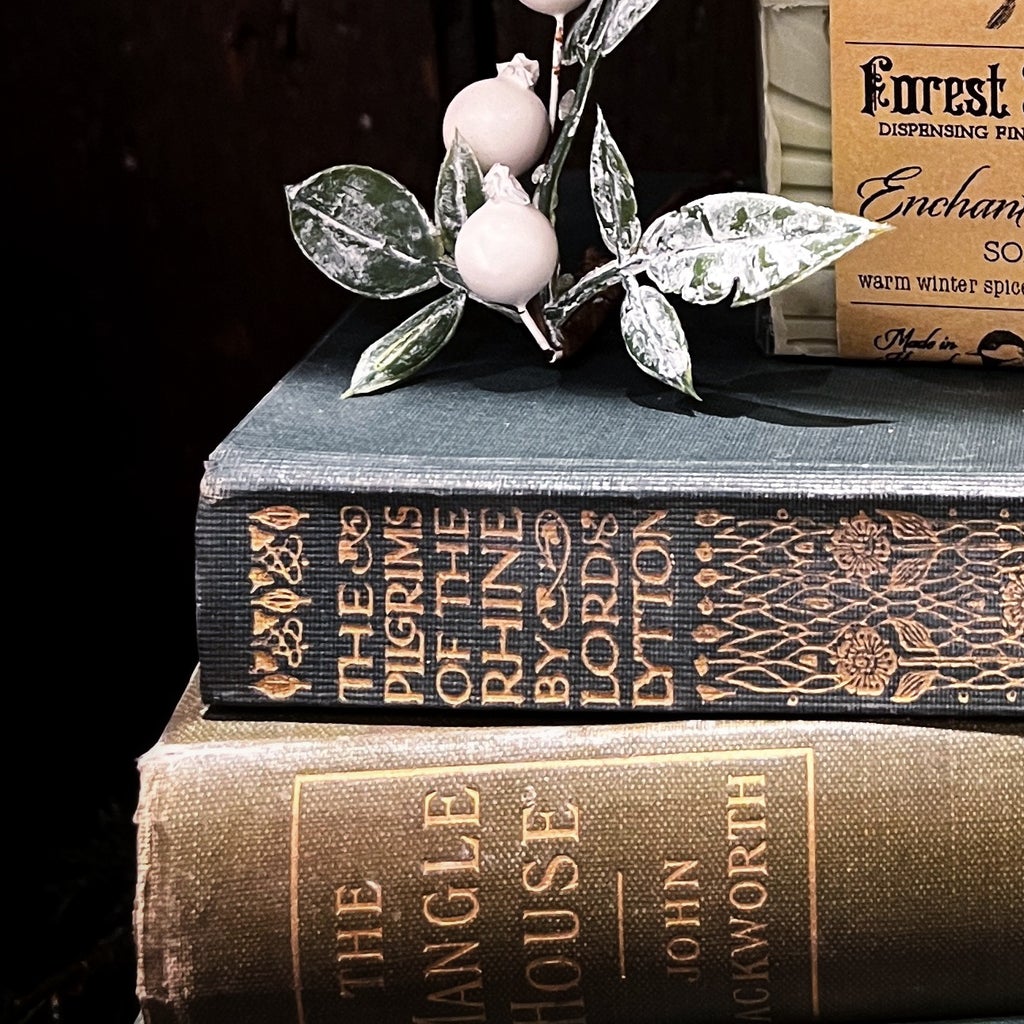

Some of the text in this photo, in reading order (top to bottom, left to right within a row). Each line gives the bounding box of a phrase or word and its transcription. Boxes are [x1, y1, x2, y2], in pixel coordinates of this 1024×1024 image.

[860, 56, 1011, 118] Forest
[878, 121, 989, 140] DISPENSING
[857, 274, 911, 292] warm
[916, 274, 978, 295] winter
[873, 328, 958, 353] Made in
[337, 582, 374, 702] THE
[384, 505, 426, 706] PILGRIMS
[433, 506, 474, 708] OF THE
[480, 505, 524, 706] RHINE
[581, 550, 622, 707] LORD
[632, 509, 675, 708] LYTTON
[534, 633, 571, 706] BY
[334, 878, 385, 998] THE
[664, 858, 701, 983] JOHN
